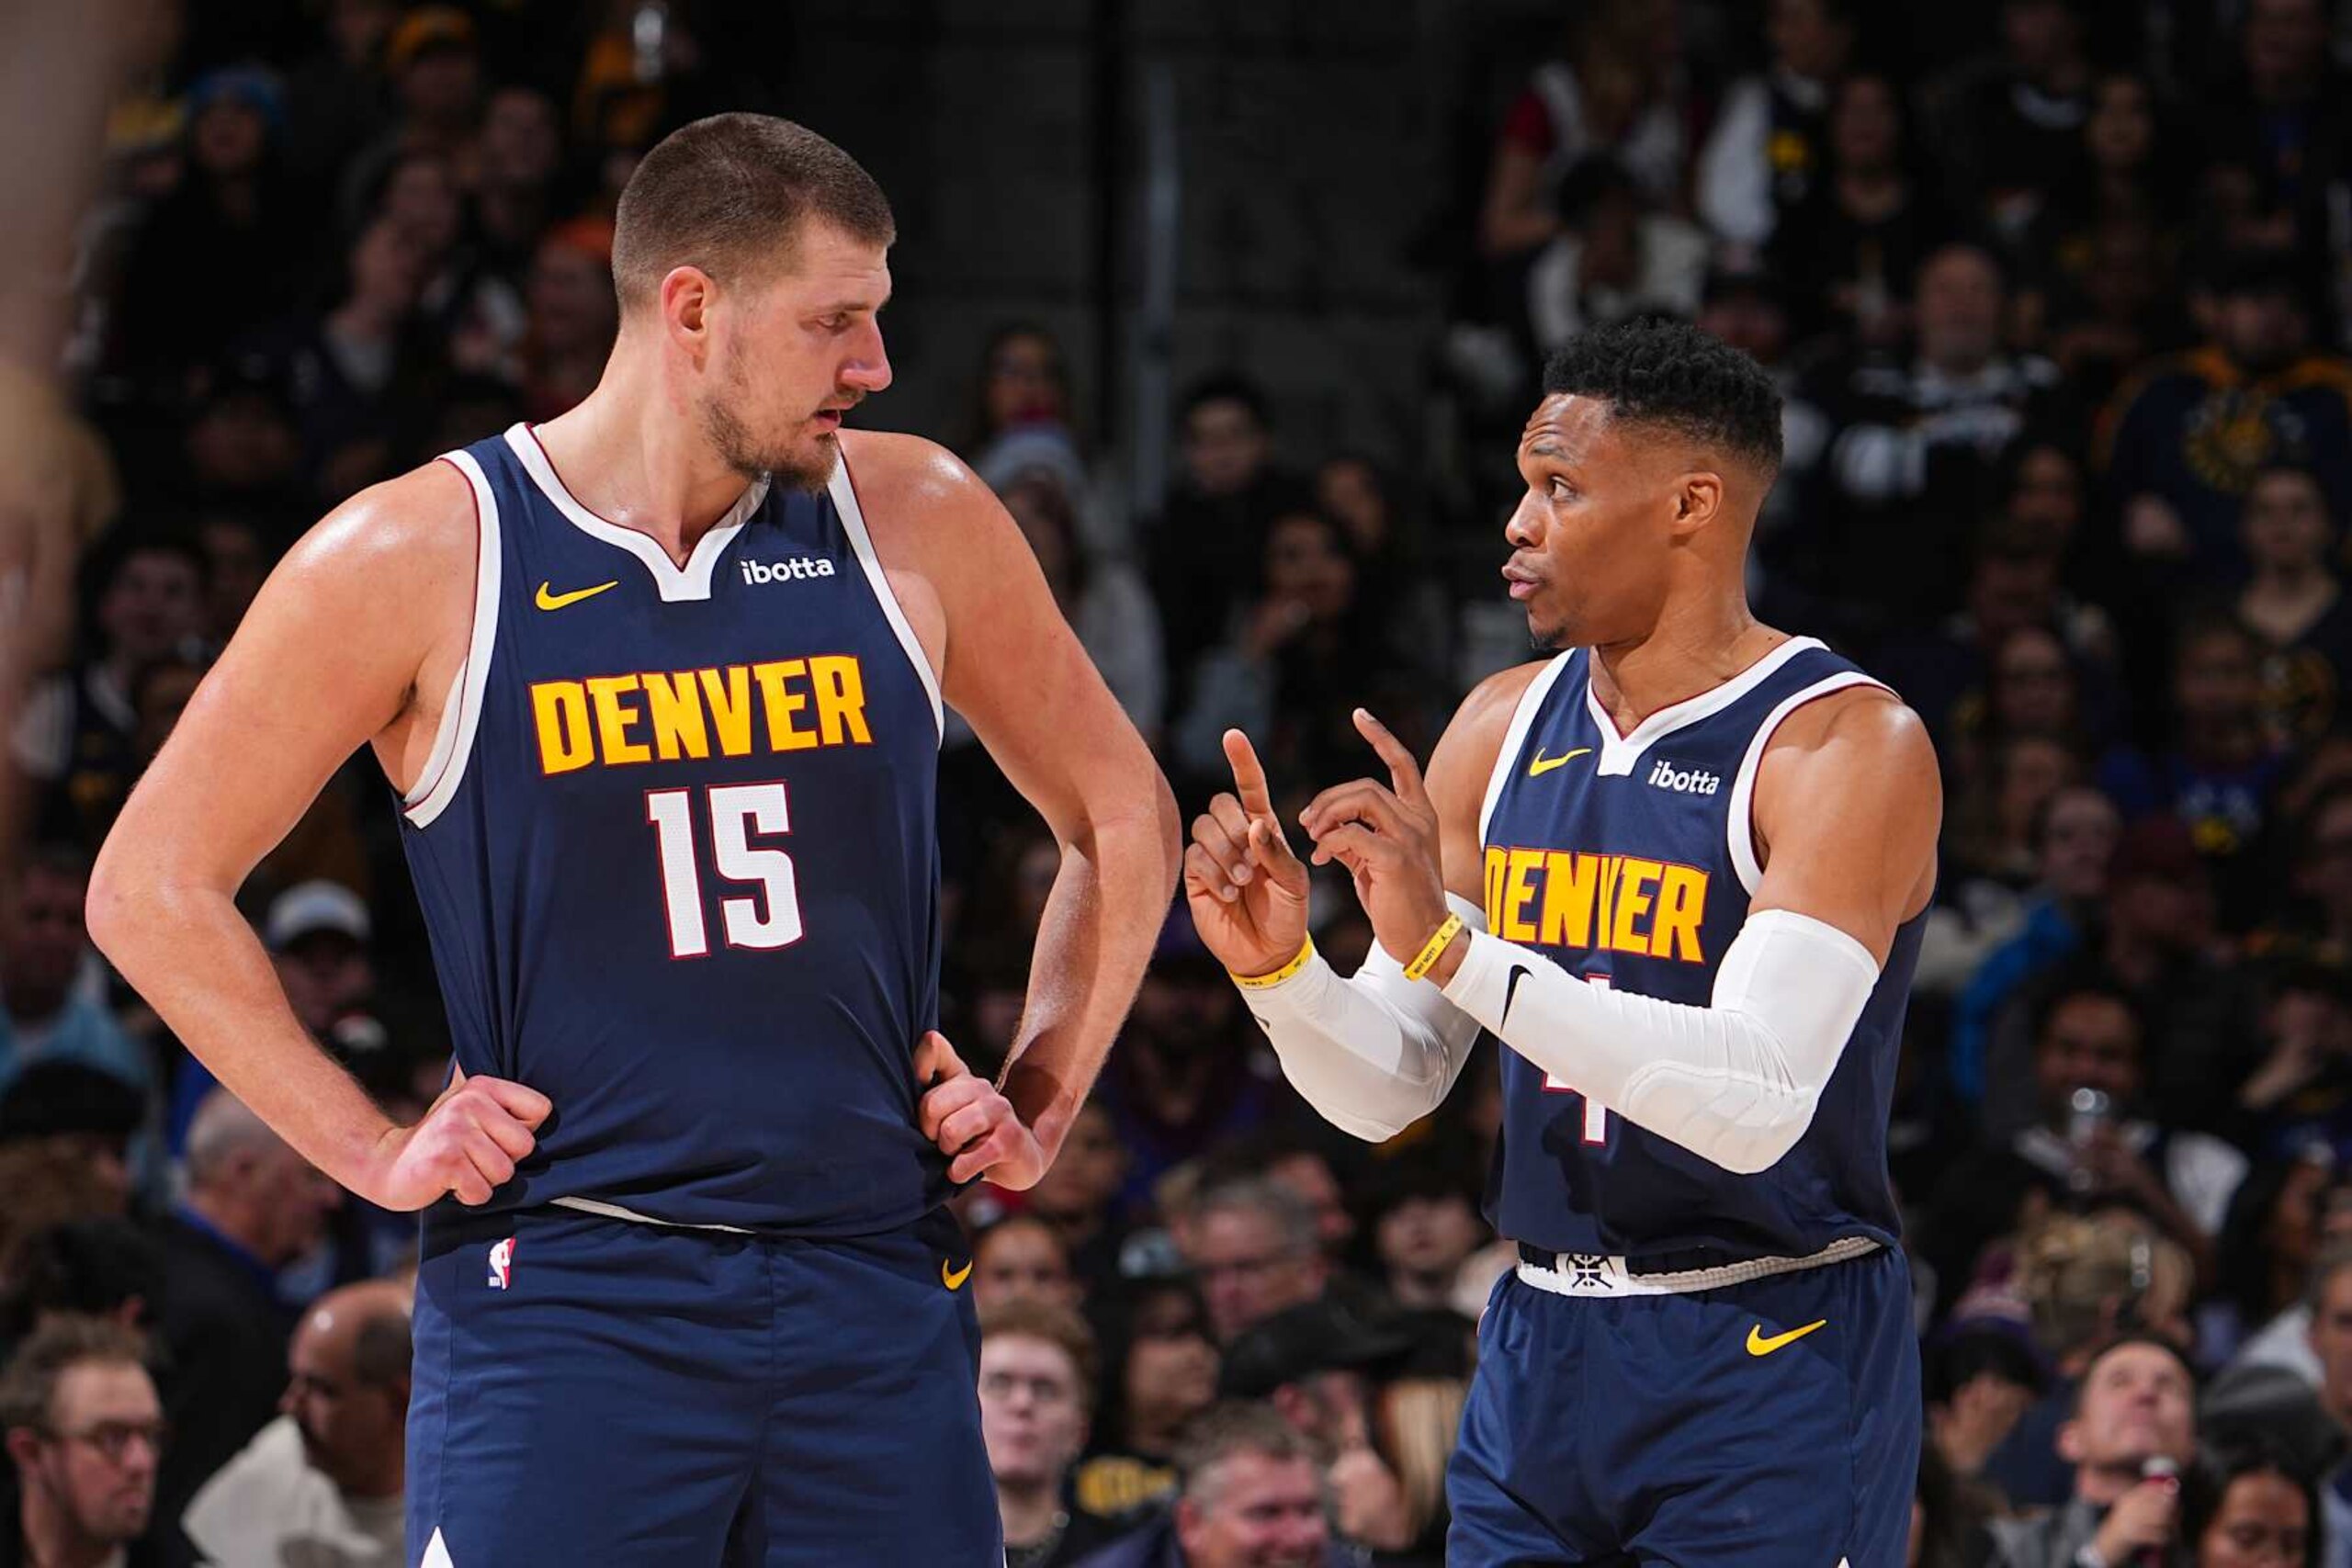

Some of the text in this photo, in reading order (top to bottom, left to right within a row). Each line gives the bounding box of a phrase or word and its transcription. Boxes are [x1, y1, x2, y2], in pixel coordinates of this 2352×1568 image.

[741, 555, 835, 586] ibotta
[528, 653, 873, 776] DENVER
[1647, 760, 1721, 796] ibotta
[644, 780, 805, 960] 15
[1485, 846, 1710, 964] DENVER
